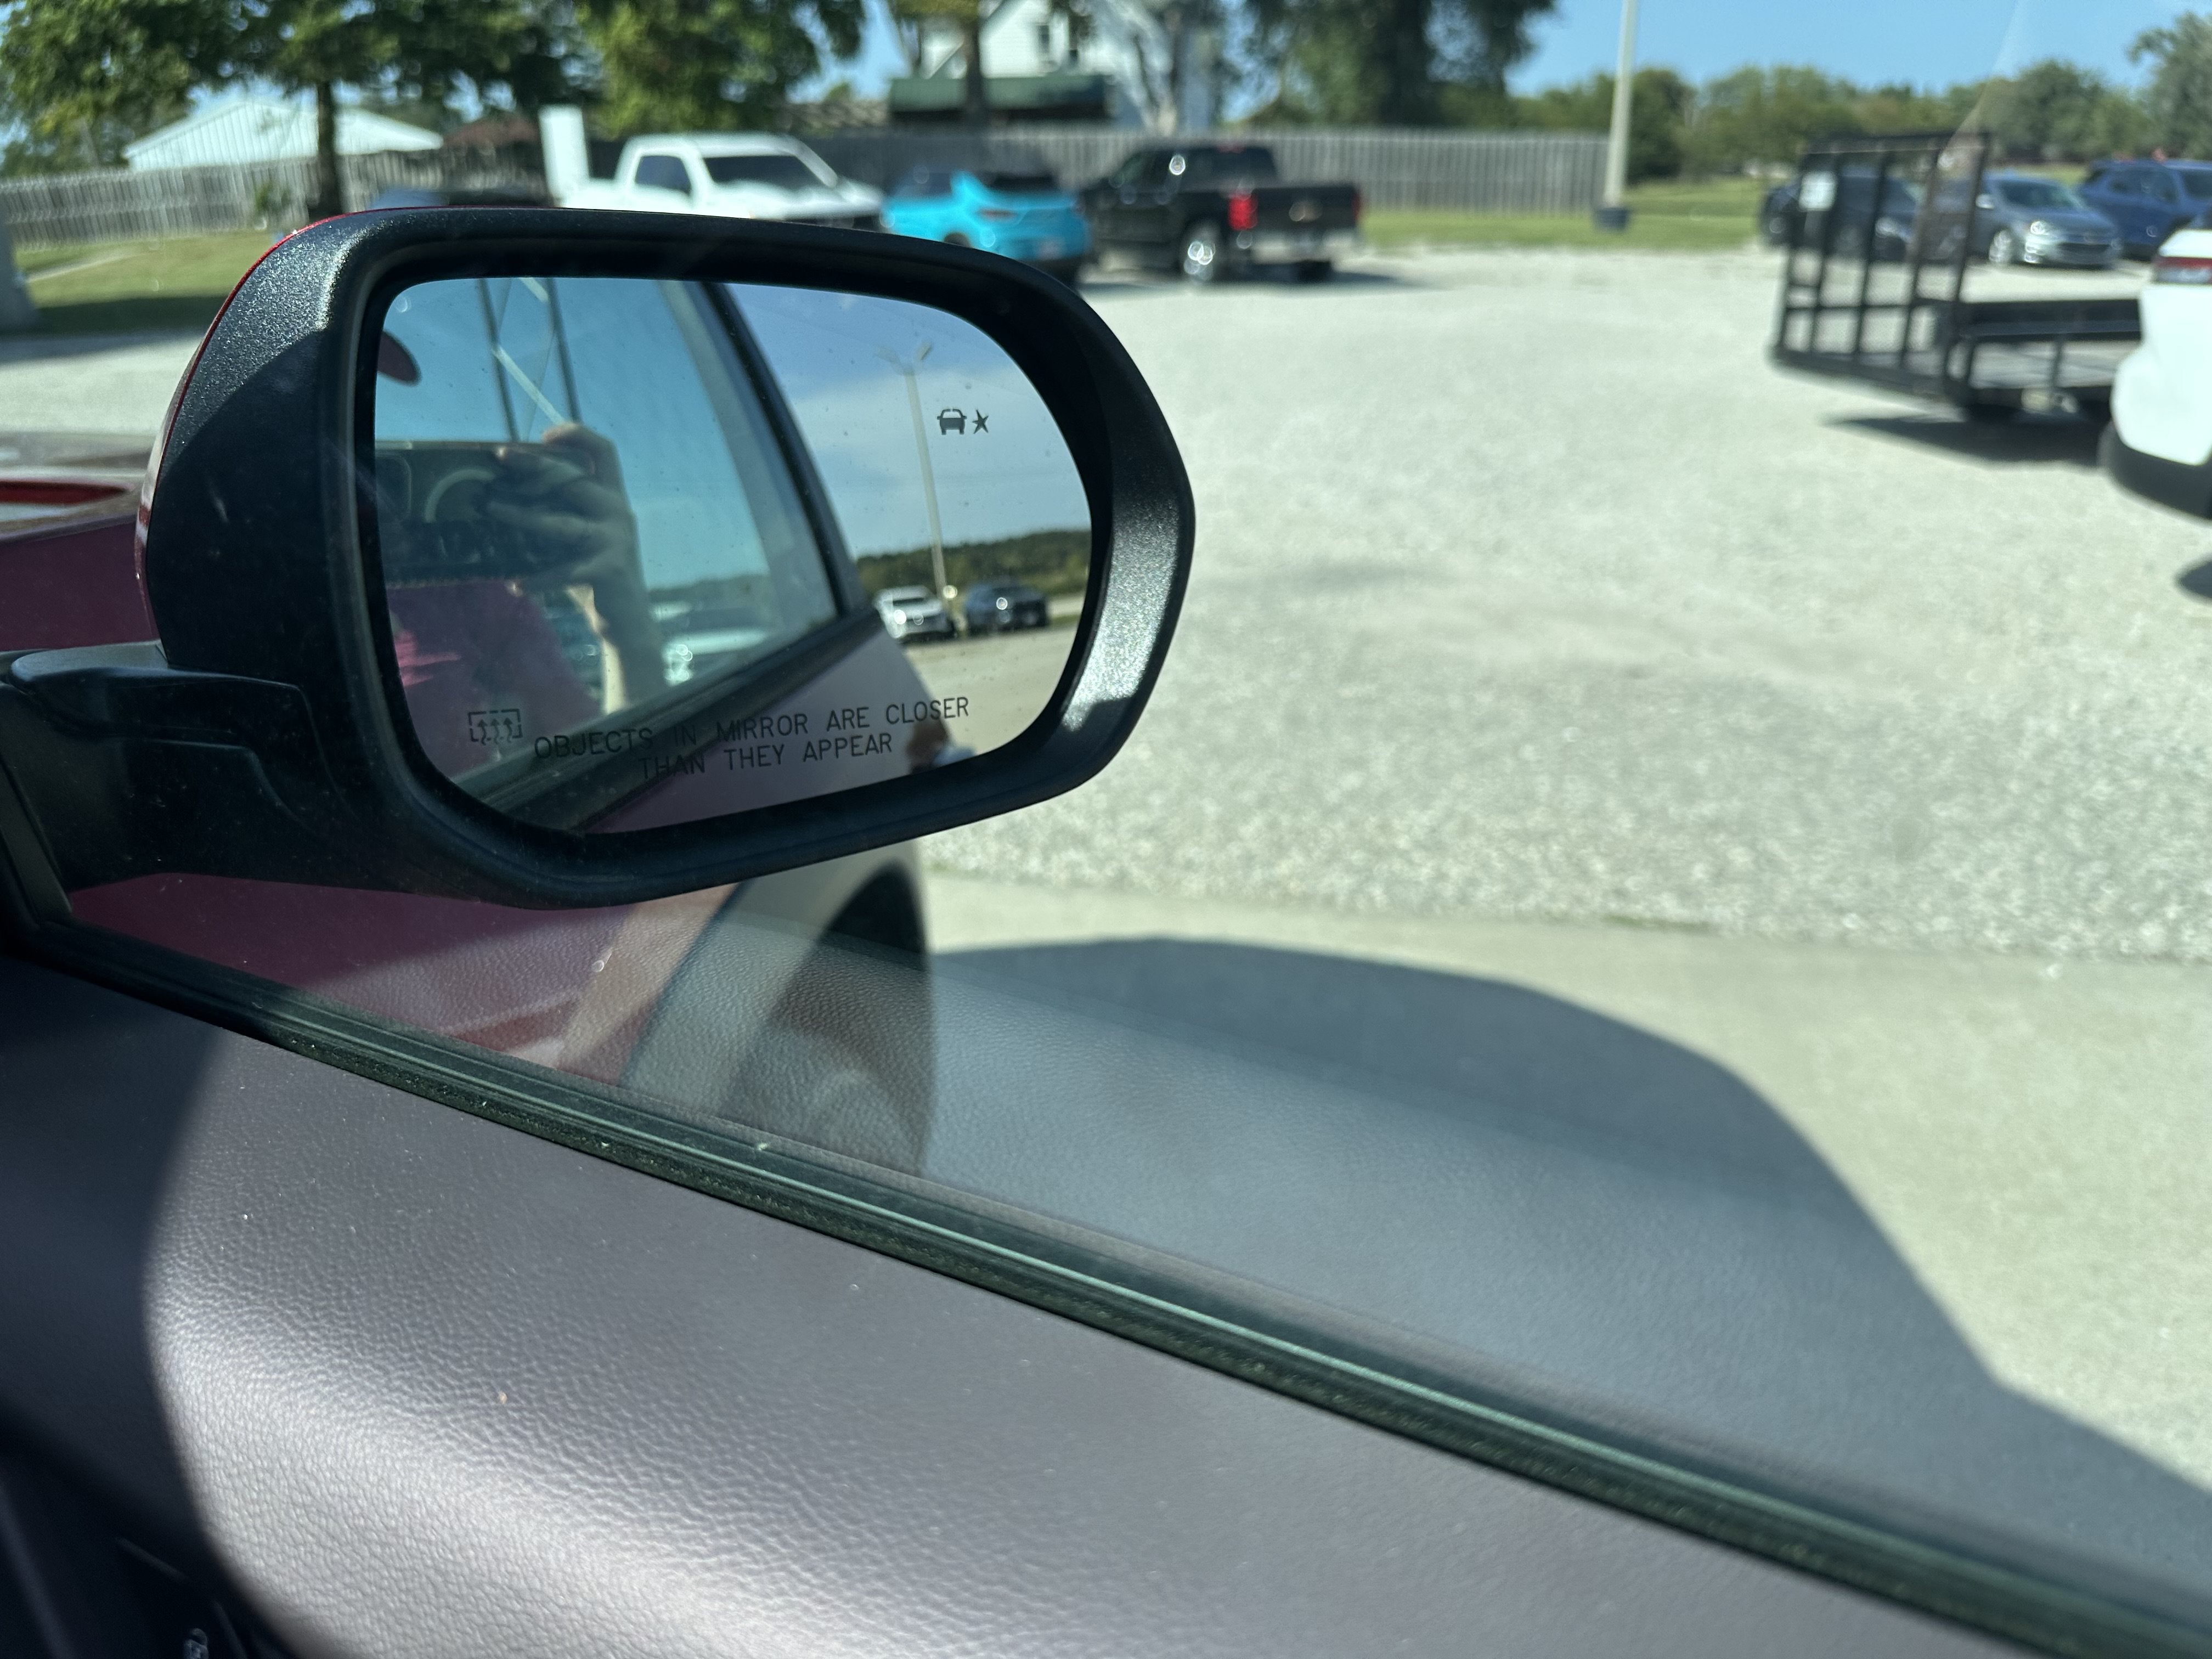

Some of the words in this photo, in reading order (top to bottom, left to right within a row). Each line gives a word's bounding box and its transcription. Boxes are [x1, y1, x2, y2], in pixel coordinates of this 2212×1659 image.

[534, 727, 653, 759] OBJECTS
[673, 723, 697, 747] IN
[717, 713, 809, 742] MIRROR
[826, 706, 870, 731] ARE
[885, 696, 970, 725] CLOSER
[639, 755, 706, 780] THAN
[723, 744, 786, 771] THEY
[802, 732, 893, 761] APPEAR
